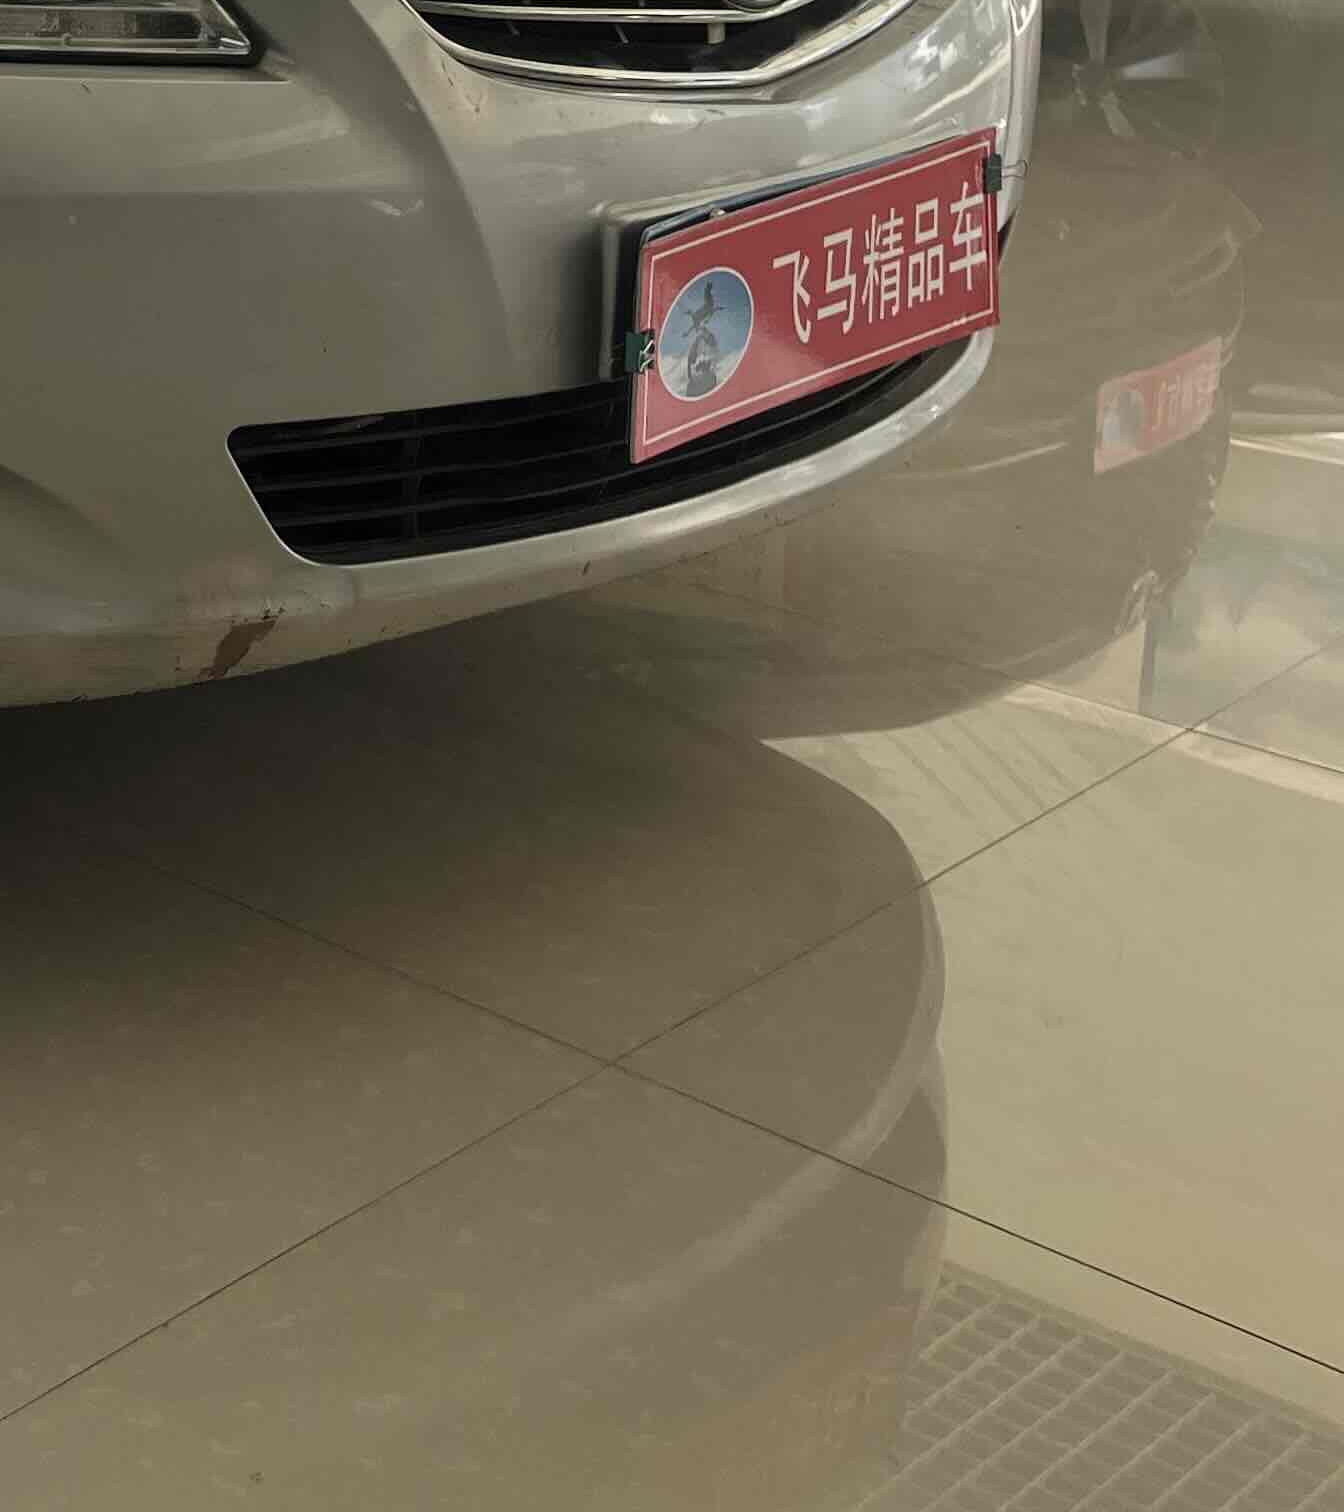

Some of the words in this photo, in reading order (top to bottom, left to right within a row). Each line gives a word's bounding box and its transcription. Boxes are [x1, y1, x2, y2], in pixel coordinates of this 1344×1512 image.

[772, 181, 988, 345] 飞马精品车
